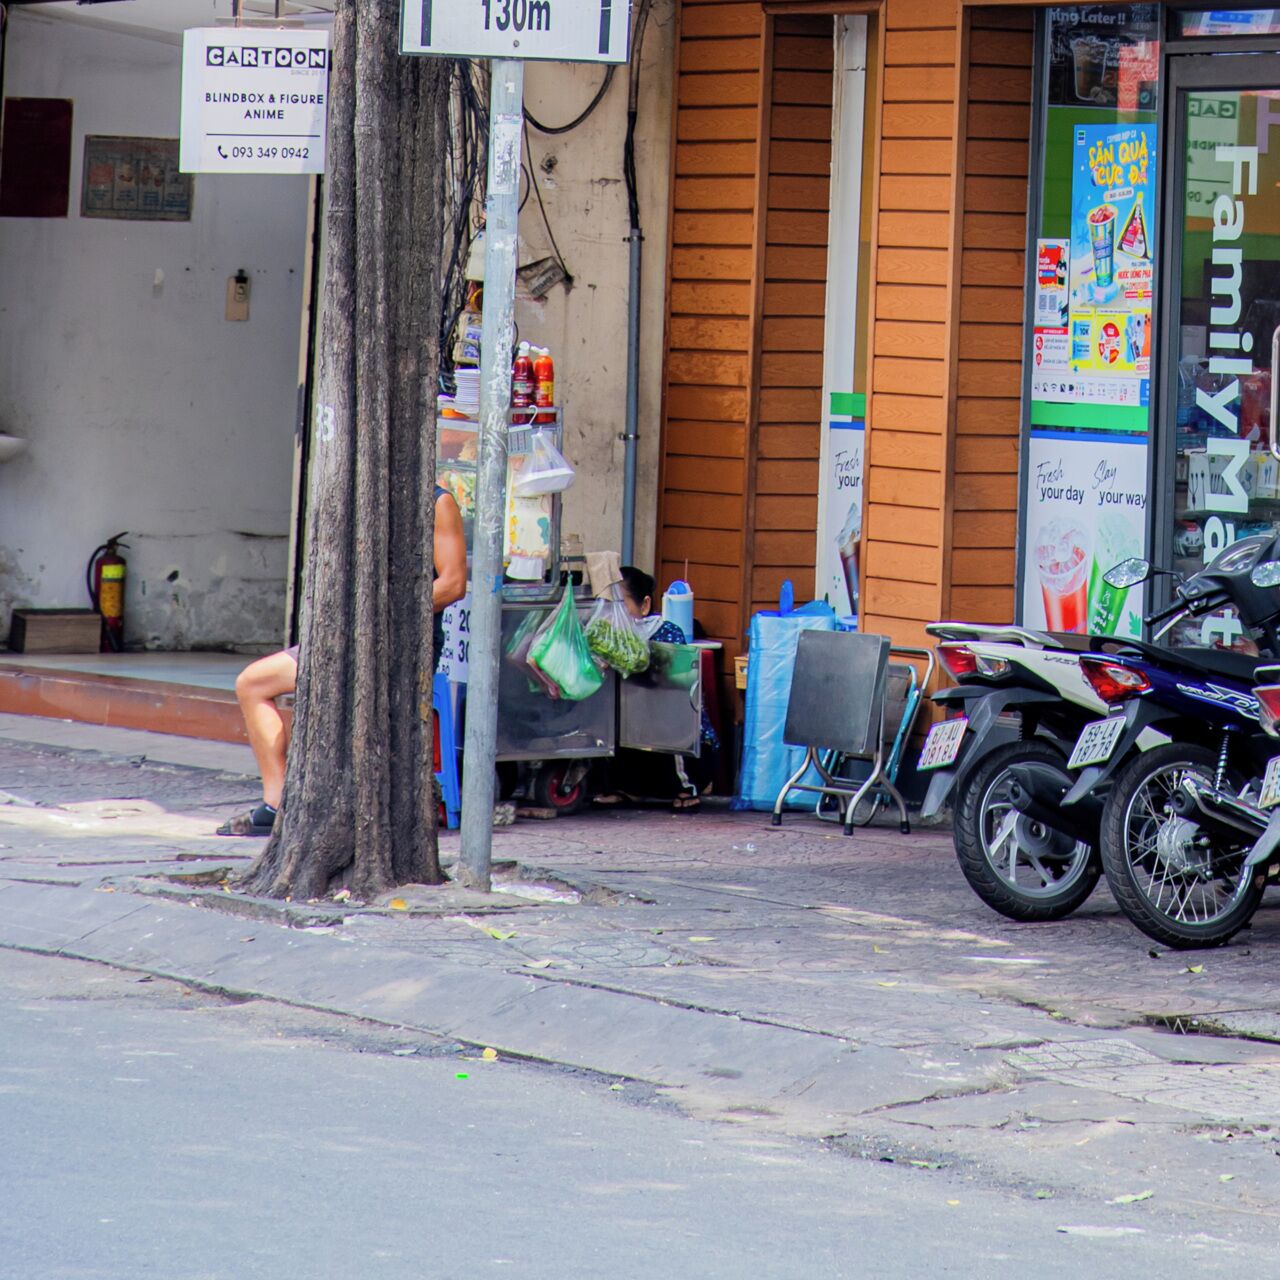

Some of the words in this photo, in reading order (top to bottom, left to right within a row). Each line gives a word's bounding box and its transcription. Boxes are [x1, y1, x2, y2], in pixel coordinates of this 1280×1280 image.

[1081, 10, 1116, 25] Later
[206, 46, 326, 69] CARTOON
[205, 92, 264, 104] BLINDBOX
[268, 94, 276, 104] &
[280, 94, 324, 105] FIGURE
[244, 109, 284, 120] ANIME
[232, 147, 253, 159] 093
[257, 147, 278, 159] 349
[281, 148, 309, 159] 0942
[1196, 145, 1258, 647] FamilyMat
[838, 475, 860, 490] your
[1037, 459, 1065, 490] Fresh
[1092, 459, 1117, 489] Slay
[1040, 486, 1064, 502] your
[1065, 485, 1085, 505] day
[1098, 490, 1124, 506] your
[1126, 493, 1147, 509] way
